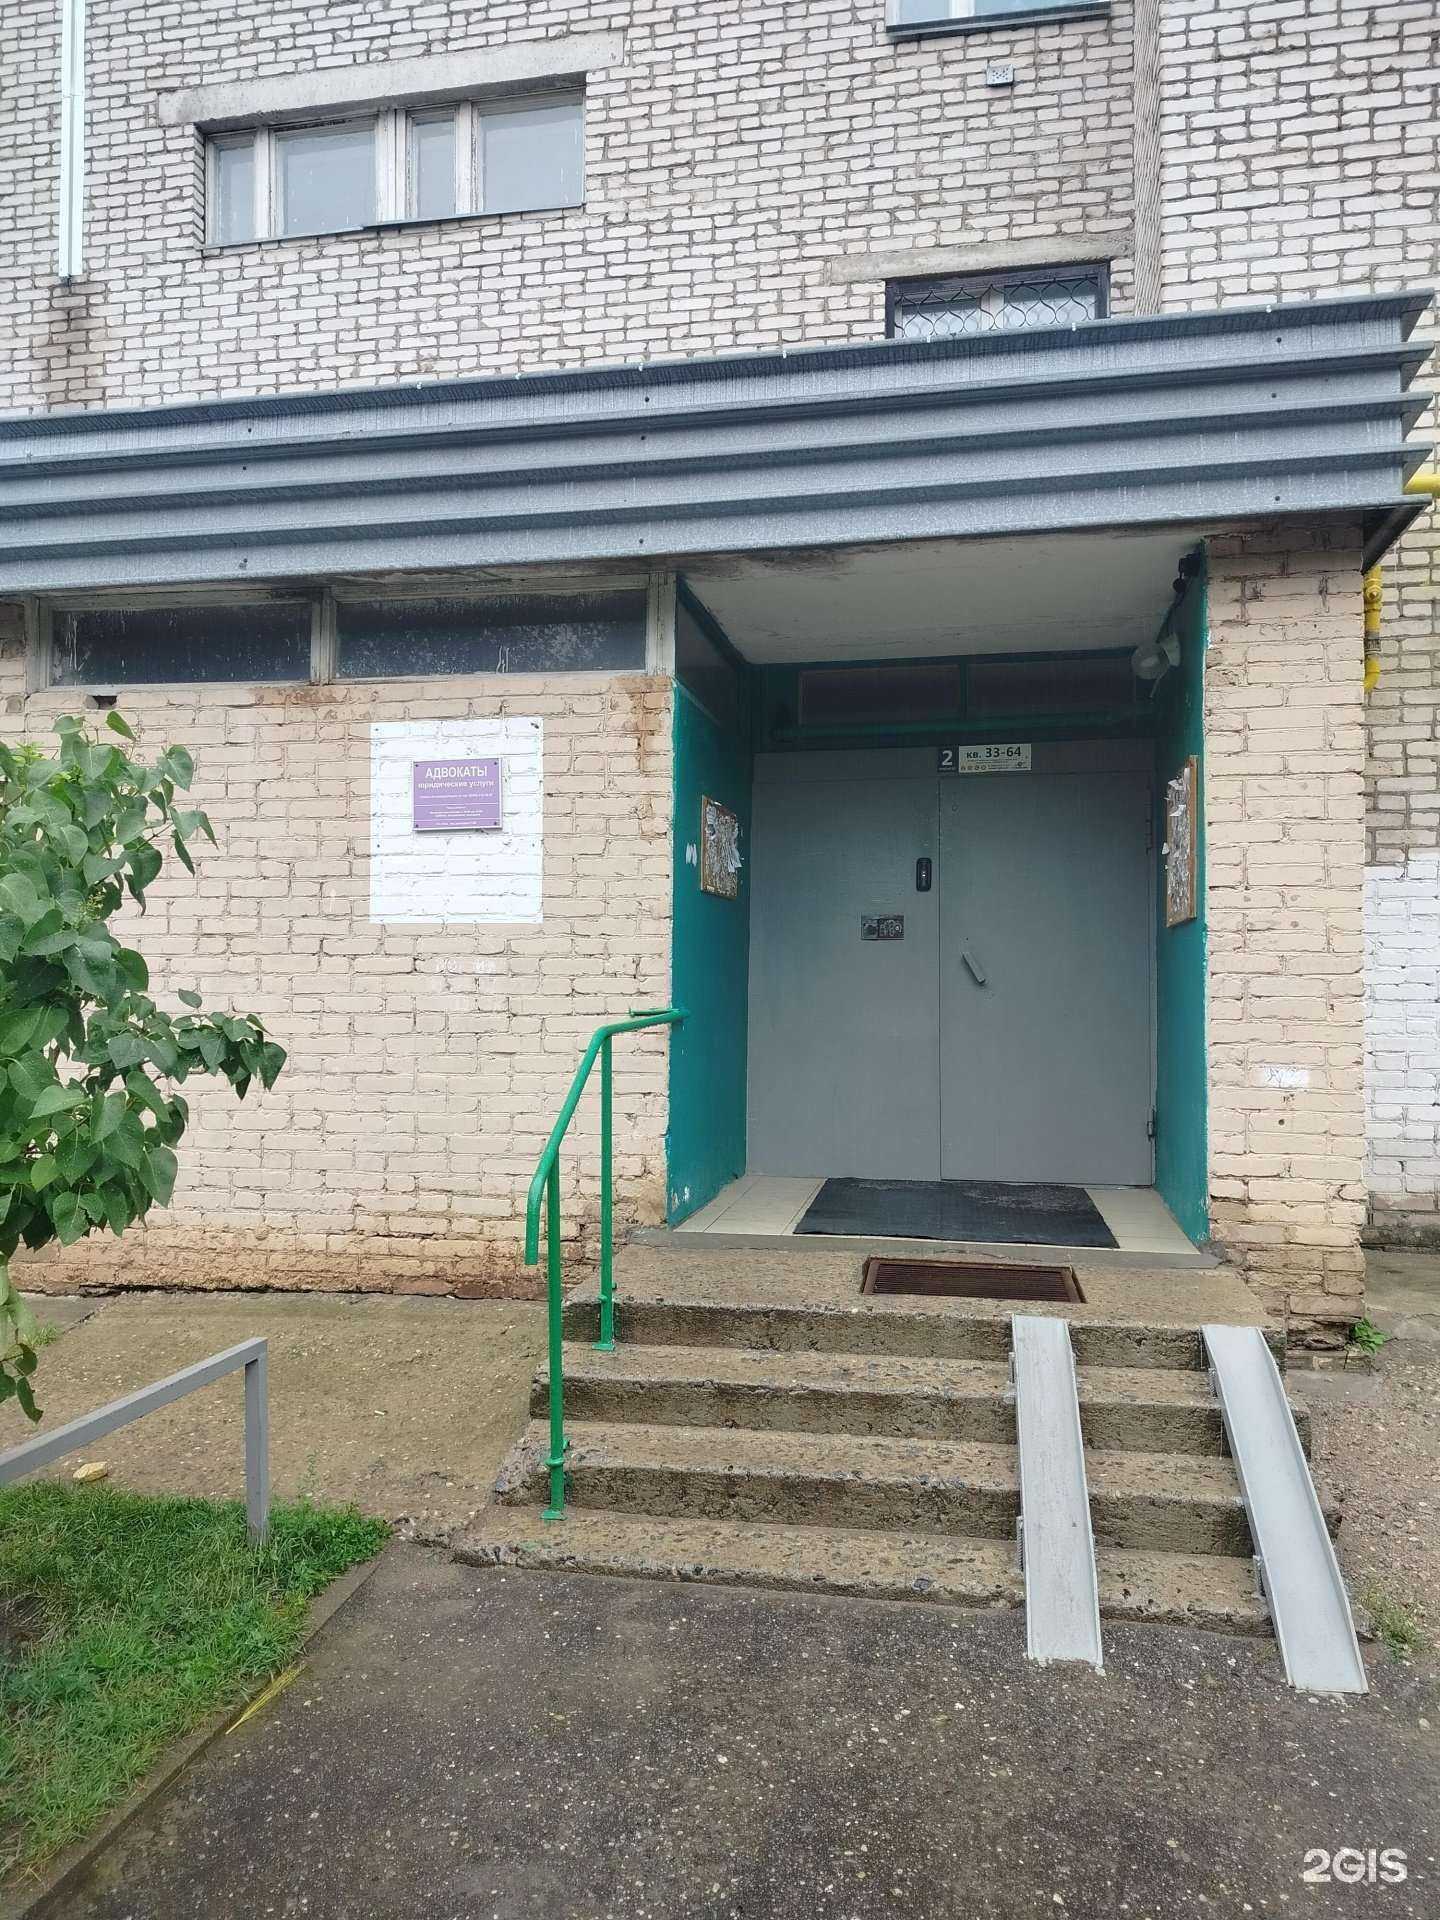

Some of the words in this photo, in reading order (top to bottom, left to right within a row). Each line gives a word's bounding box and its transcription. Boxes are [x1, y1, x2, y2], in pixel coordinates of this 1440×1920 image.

[941, 749, 954, 766] 2
[966, 751, 982, 759] кв.
[985, 746, 1021, 758] 33-64
[425, 765, 488, 780] АДВОКАТЫ
[418, 781, 468, 790] юридические
[469, 780, 495, 789] услуги
